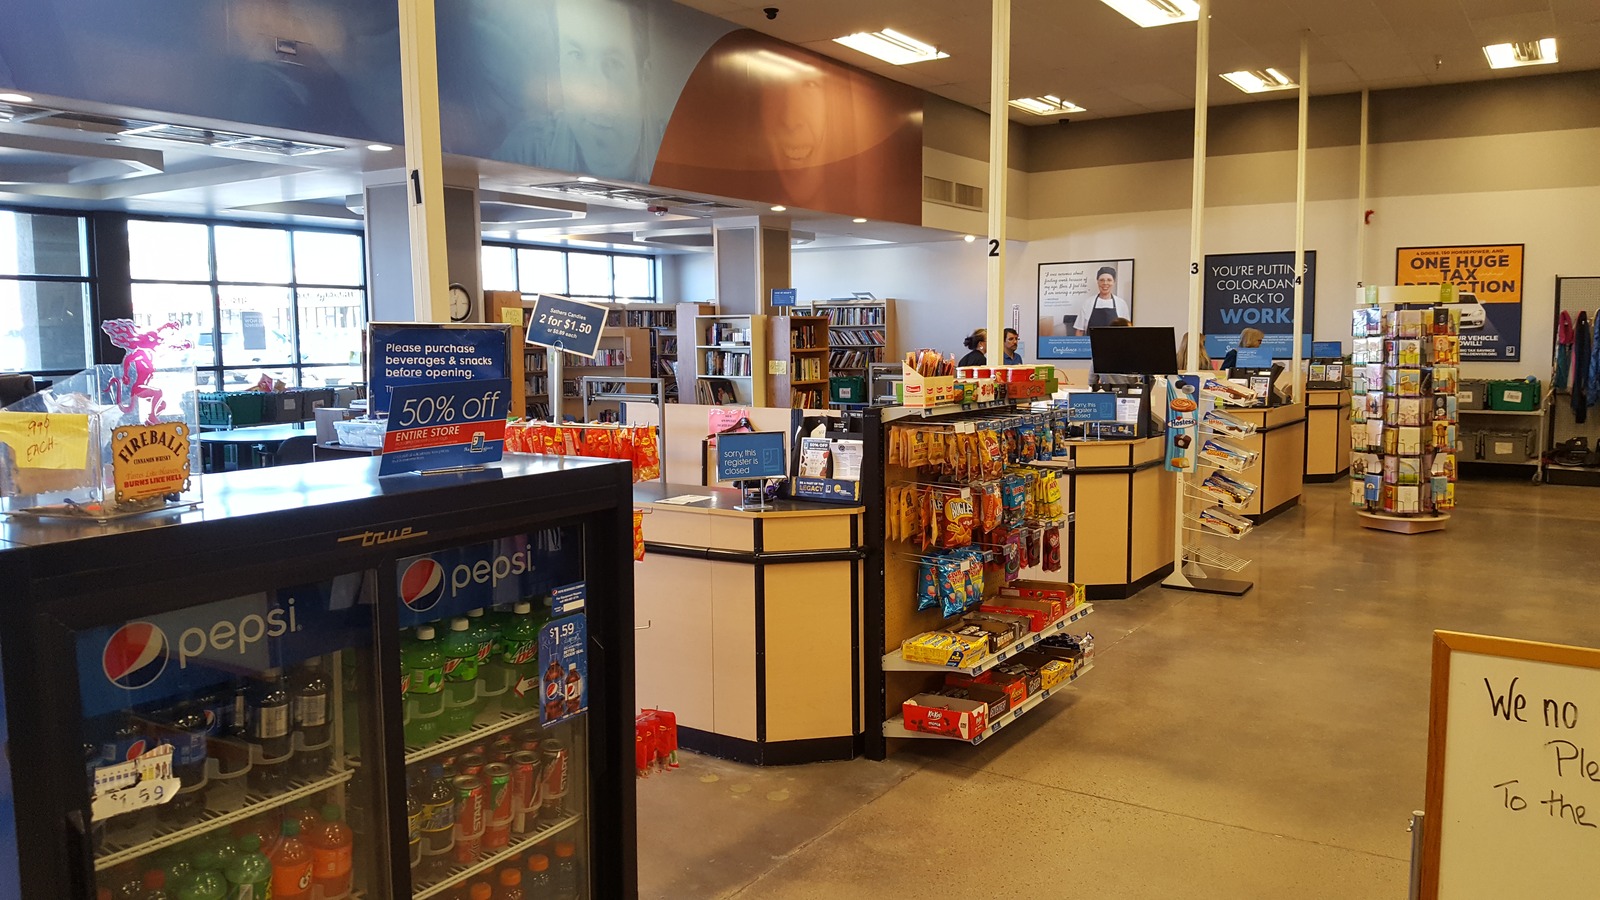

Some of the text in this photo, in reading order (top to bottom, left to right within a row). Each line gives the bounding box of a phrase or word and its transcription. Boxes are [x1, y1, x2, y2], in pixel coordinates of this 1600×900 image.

[411, 170, 422, 204] 1
[988, 239, 1000, 256] 2
[1191, 262, 1198, 274] 3
[1410, 255, 1510, 269] ONE HUGE
[1212, 265, 1254, 276] YOU'RE
[1440, 268, 1477, 280] TAX
[1216, 279, 1295, 290] COLORADAN
[1296, 276, 1302, 285] 4
[1233, 293, 1284, 304] BACK TO
[568, 312, 587, 320] Candies
[1220, 308, 1294, 324] WORK.
[539, 314, 592, 334] 2 for $1.50
[386, 344, 475, 355] Please purchase
[385, 356, 492, 367] beverages & snacks
[385, 368, 475, 380] before opening.
[399, 391, 501, 426] 50% off
[396, 426, 460, 442] ENTIRE STORE
[26, 436, 54, 462] EACH
[118, 430, 183, 464] FIREBALL
[724, 450, 744, 458] sorry,
[134, 456, 154, 464] CINNAMON
[724, 459, 751, 467] register
[724, 467, 750, 475] closed
[124, 474, 182, 488] BURNS LIKE HELL
[452, 544, 532, 598] pepsi
[178, 598, 296, 669] pepsi
[550, 622, 574, 645] $1.59
[1484, 677, 1578, 729] We no
[1493, 780, 1597, 828] To the
[473, 794, 482, 831] START
